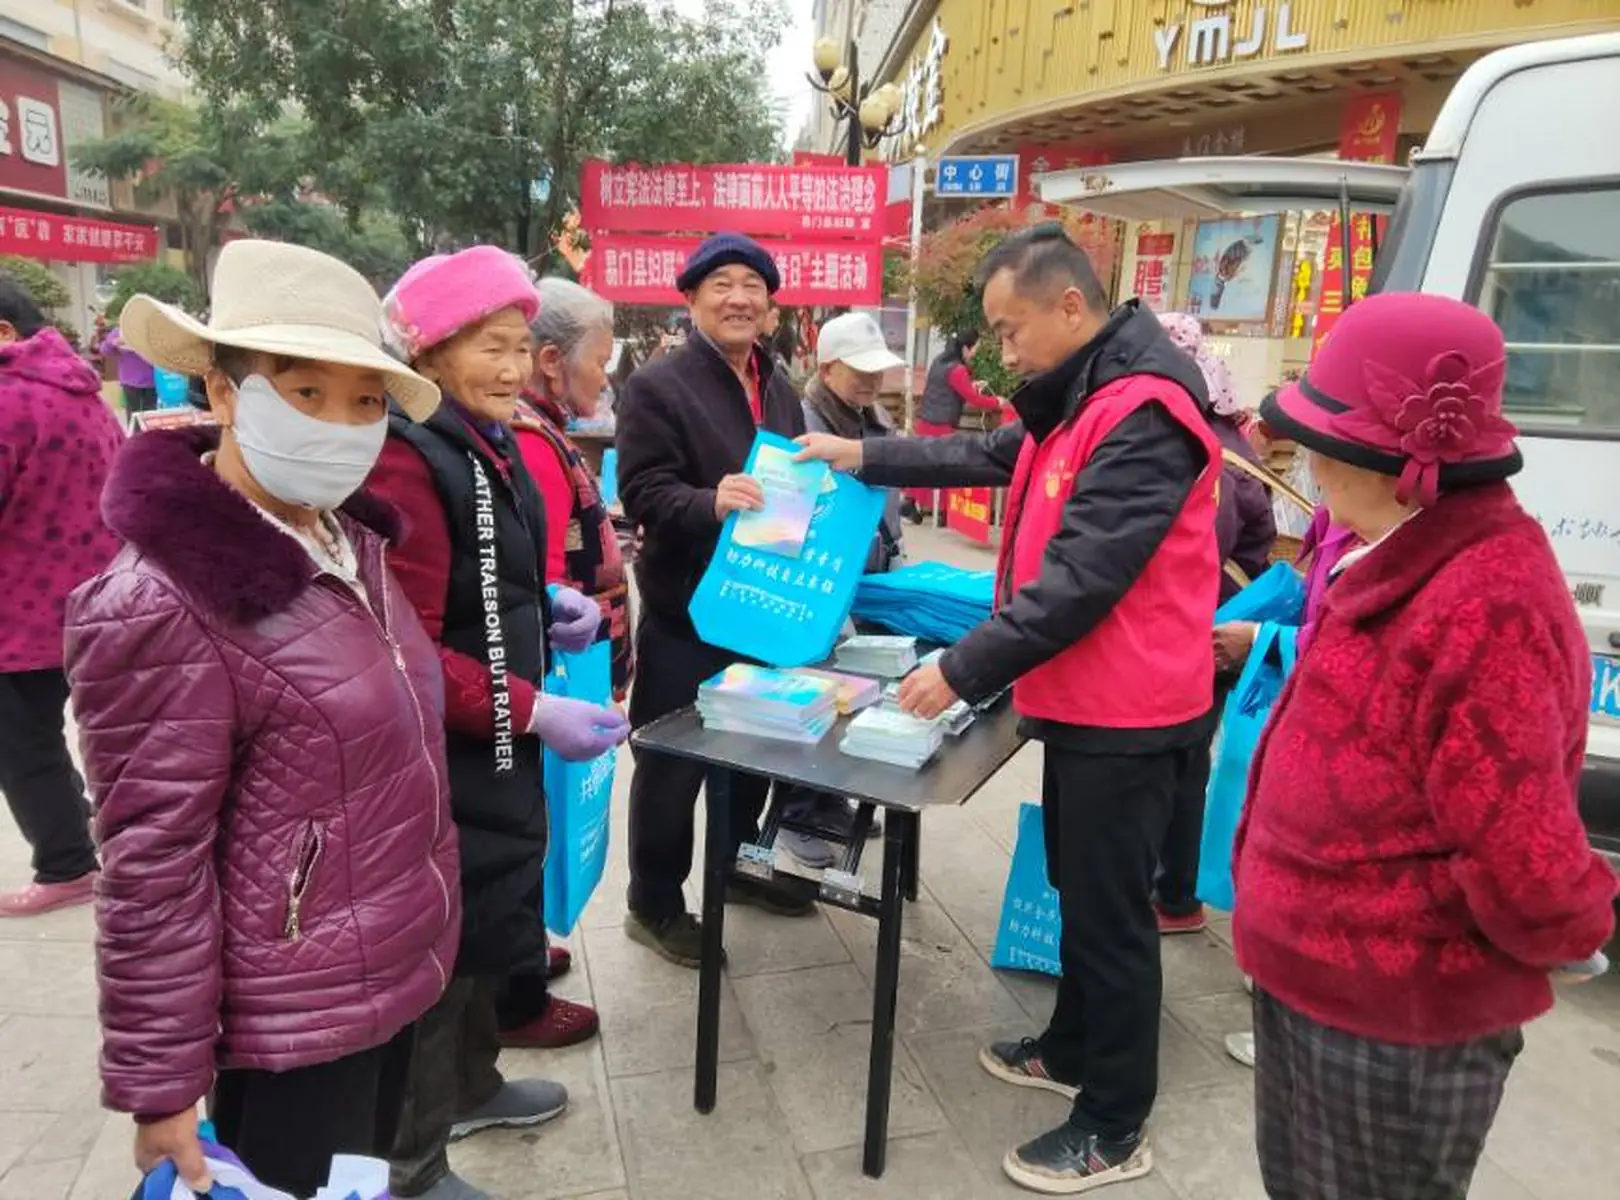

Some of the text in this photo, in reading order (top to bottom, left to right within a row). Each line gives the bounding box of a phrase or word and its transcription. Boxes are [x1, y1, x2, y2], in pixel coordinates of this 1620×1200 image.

[943, 163, 1010, 181] 中心街
[479, 544, 503, 643] TRAESON
[487, 646, 508, 687] BUT
[493, 691, 513, 773] RATHER
